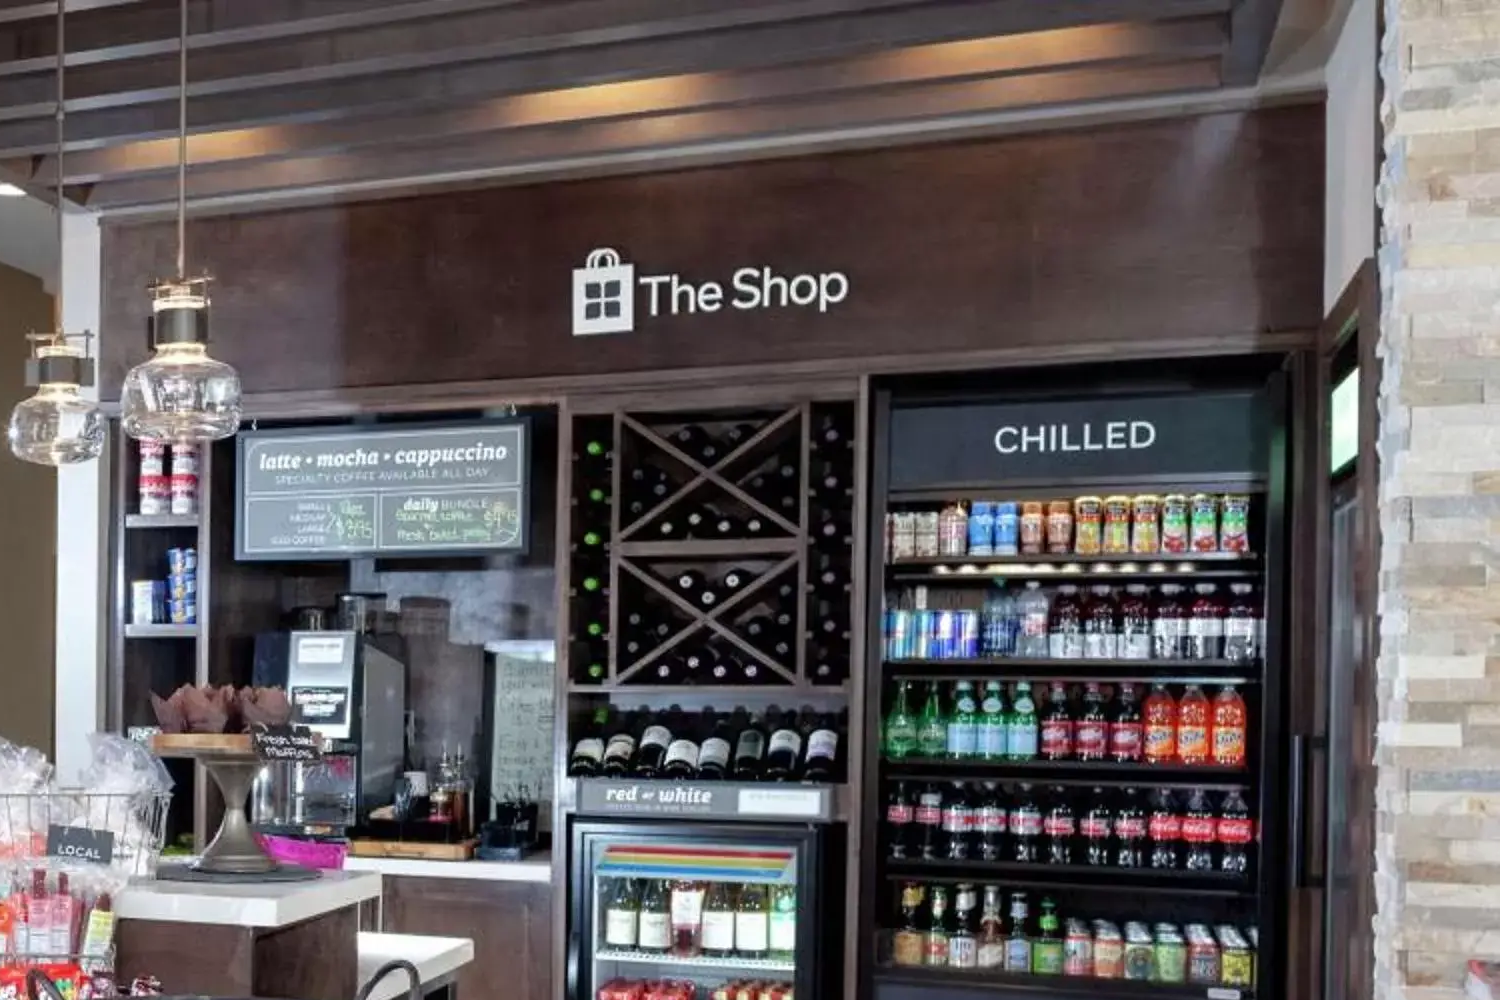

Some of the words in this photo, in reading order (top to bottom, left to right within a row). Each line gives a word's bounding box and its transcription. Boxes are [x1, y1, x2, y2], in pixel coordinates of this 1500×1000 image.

[639, 274, 723, 316] The
[732, 266, 849, 313] Shop
[993, 421, 1156, 454] CHILLED
[259, 453, 302, 470] latte
[317, 448, 379, 467] mocha
[395, 442, 508, 468] cappuccino
[334, 471, 376, 483] COFFEE
[379, 469, 437, 481] AVAILABLE
[466, 466, 490, 477] DAY
[404, 498, 438, 512] daily
[606, 785, 638, 801] red
[659, 786, 713, 804] white
[57, 843, 102, 859] LOCAL
